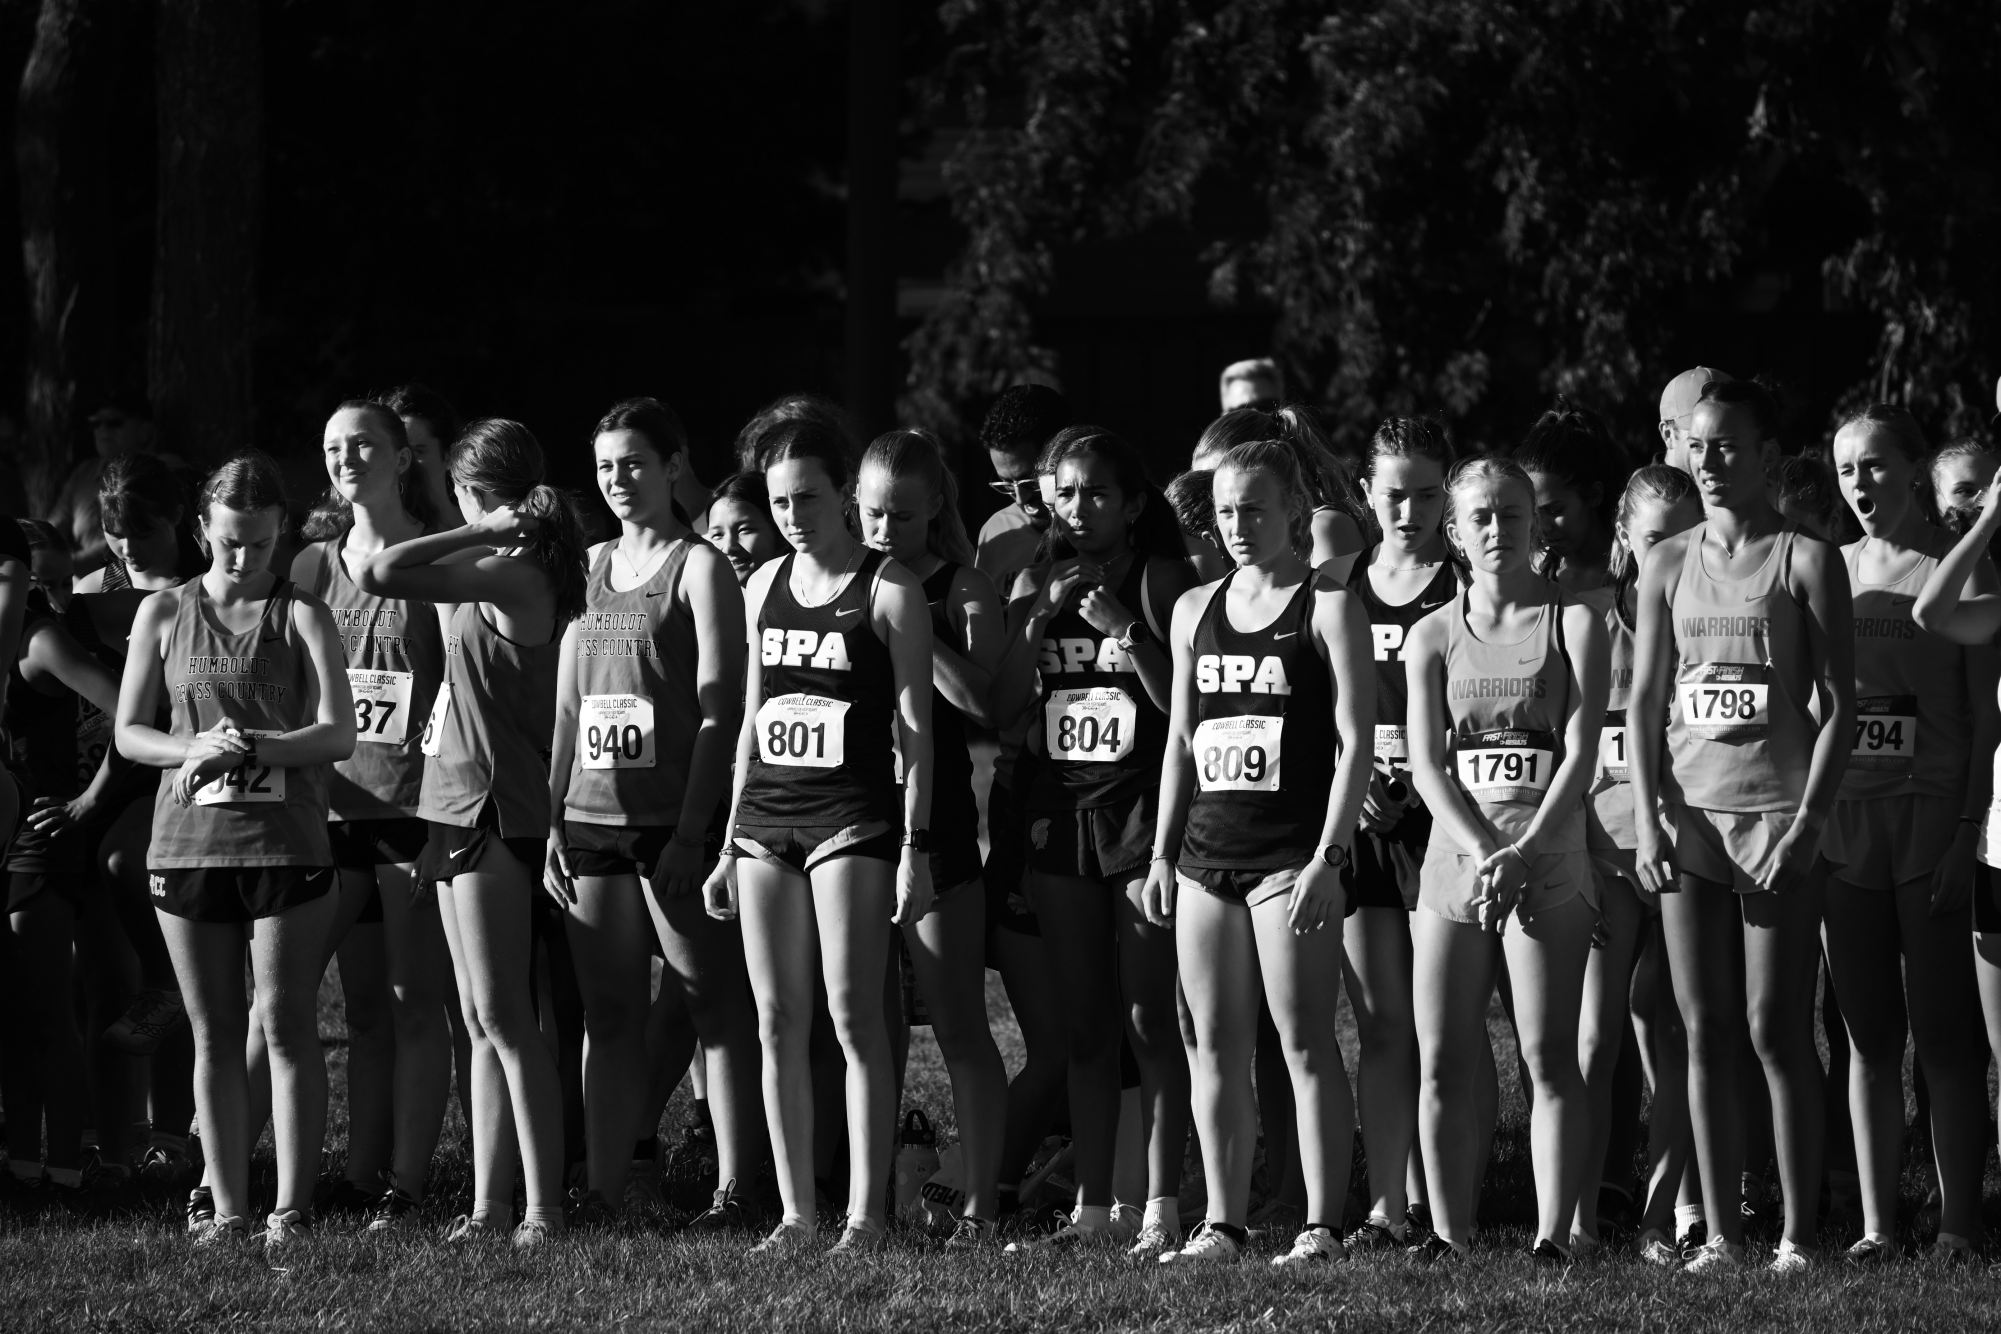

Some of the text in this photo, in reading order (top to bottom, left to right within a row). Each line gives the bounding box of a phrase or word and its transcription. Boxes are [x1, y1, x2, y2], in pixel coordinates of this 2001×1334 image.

[331, 608, 397, 628] UMBOLDT
[580, 613, 647, 631] HUMBOLDT
[1681, 616, 1771, 638] WARRIORS
[1853, 617, 1917, 640] RRIORS
[350, 634, 413, 655] COUNTRY
[577, 638, 662, 659] OSS COUNTRY
[761, 627, 853, 672] SPA
[1038, 637, 1136, 675] SPA
[188, 656, 269, 675] HUMBOLDT
[1196, 654, 1293, 696] SPA
[346, 673, 397, 686] WBELL CLASSIC
[1451, 677, 1547, 700] WARRIORS
[174, 681, 287, 704] CROSS COUNTRY
[612, 698, 638, 709] CLASSIC
[777, 697, 834, 708] COWBELL CLASSIC
[1688, 688, 1756, 720] 1798
[354, 698, 397, 735] 37
[1239, 719, 1267, 730] CLASSIC
[588, 724, 643, 761] 940
[768, 720, 825, 758] 801
[1057, 715, 1121, 753] 804
[1379, 729, 1406, 740] CLASSIC
[1482, 732, 1502, 742] FAST
[1852, 720, 1904, 751] 794
[1203, 745, 1267, 783] 809
[1468, 753, 1538, 784] 1791
[921, 1182, 960, 1207] FIELD
